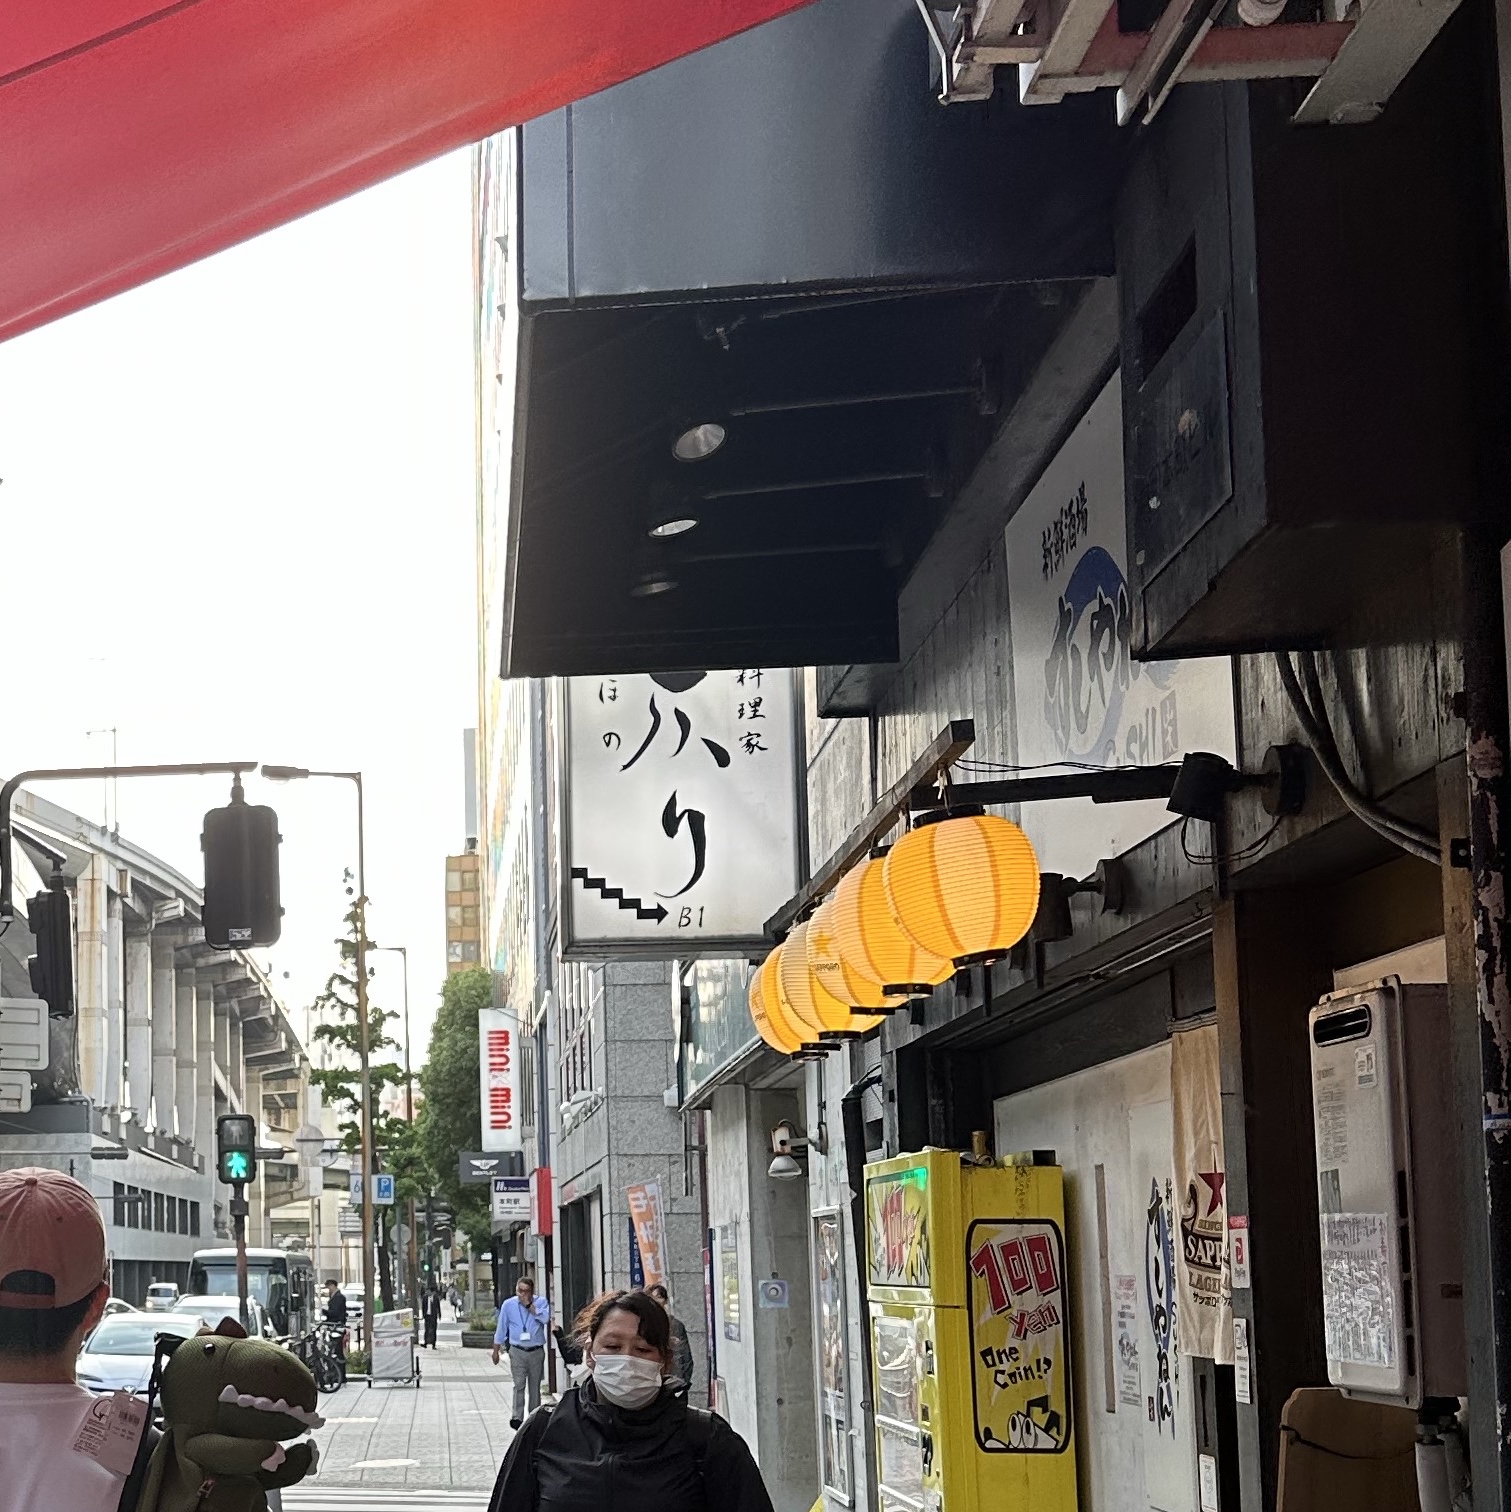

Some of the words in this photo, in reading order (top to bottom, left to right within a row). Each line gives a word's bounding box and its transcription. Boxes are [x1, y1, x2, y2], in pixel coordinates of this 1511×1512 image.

[489, 1087, 513, 1130] mini
[970, 1233, 1060, 1315] 100
[979, 1345, 1020, 1369] One
